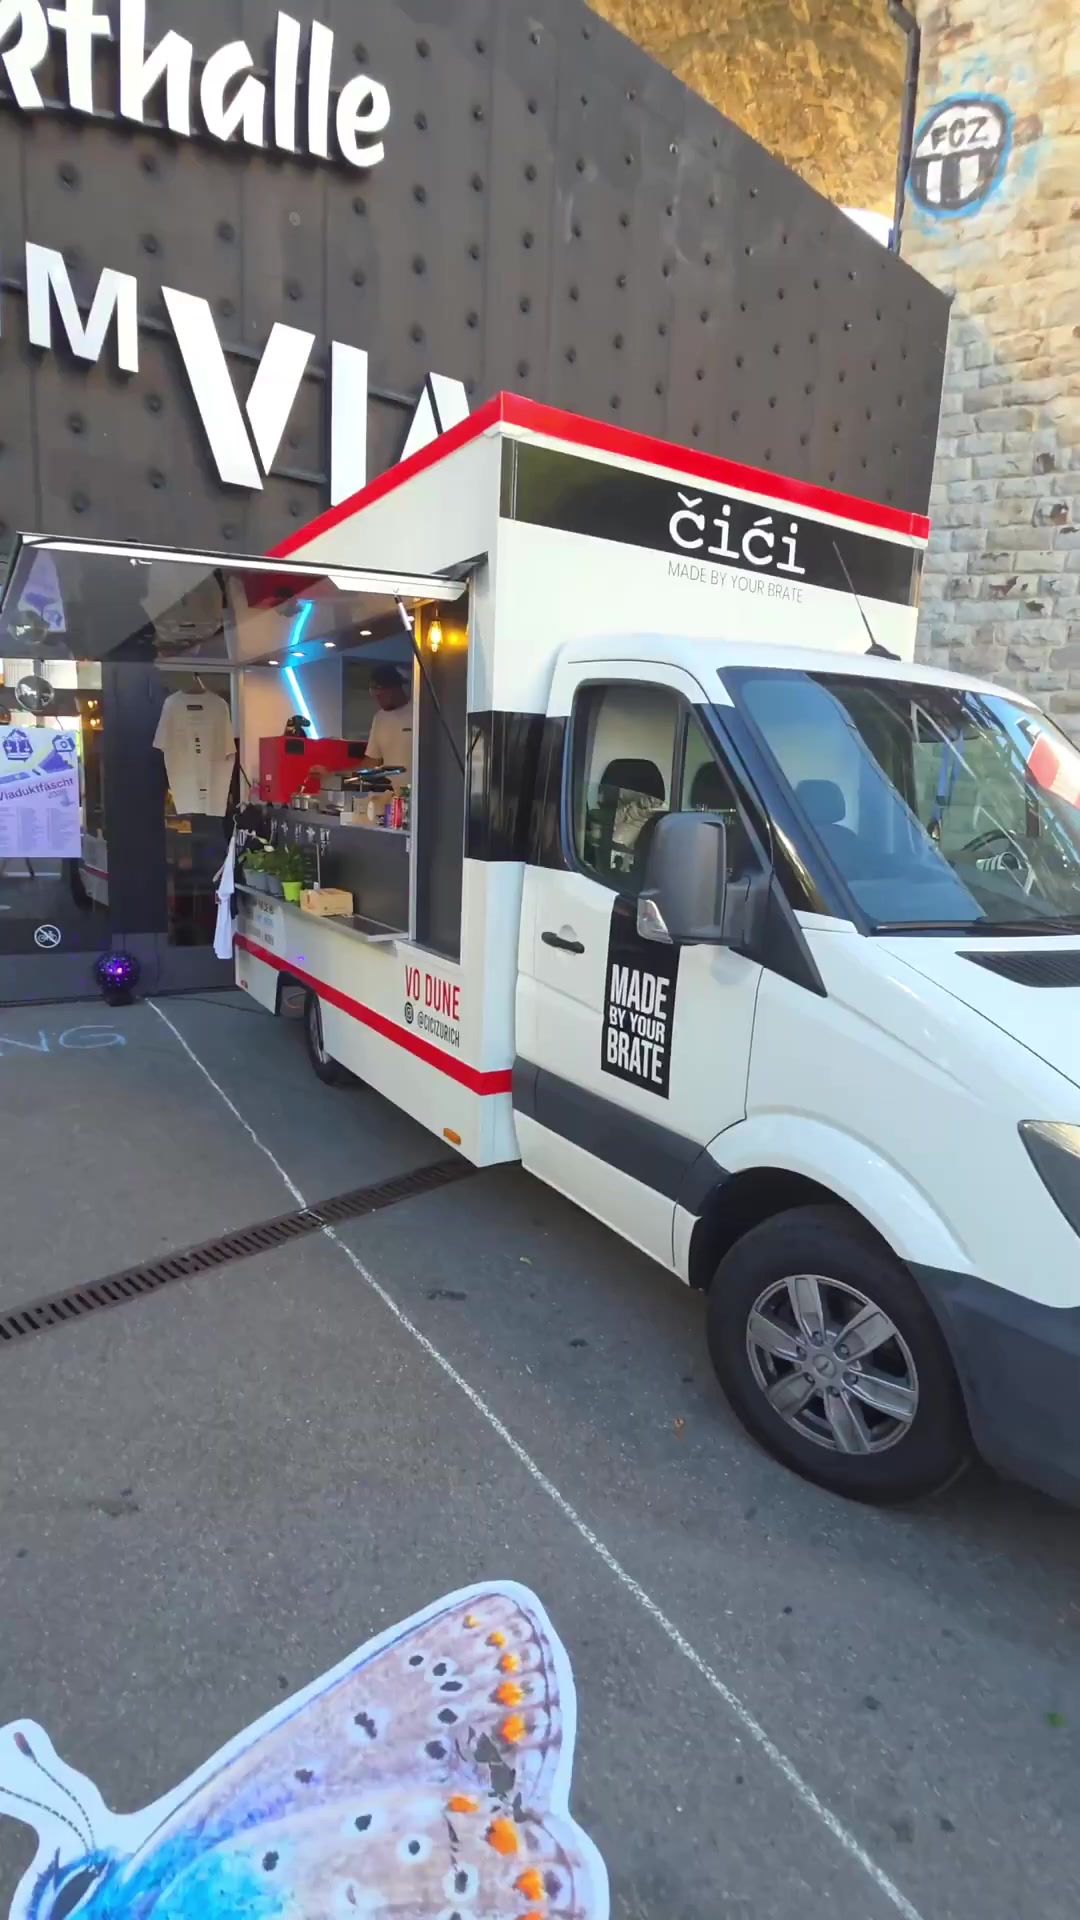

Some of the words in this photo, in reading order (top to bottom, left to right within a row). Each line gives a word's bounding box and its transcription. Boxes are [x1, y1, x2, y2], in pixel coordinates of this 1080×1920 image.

[931, 116, 989, 151] FCZ
[669, 491, 805, 574] čići
[668, 560, 706, 583] MADE
[711, 569, 728, 587] BY
[731, 575, 765, 594] YOUR
[768, 582, 803, 603] BRATE
[405, 964, 420, 1001] VO
[425, 973, 460, 1021] DUNE
[610, 964, 670, 1020] MADE
[609, 1004, 626, 1028] BY
[630, 1011, 666, 1045] YOUR
[607, 1026, 664, 1085] BRATE
